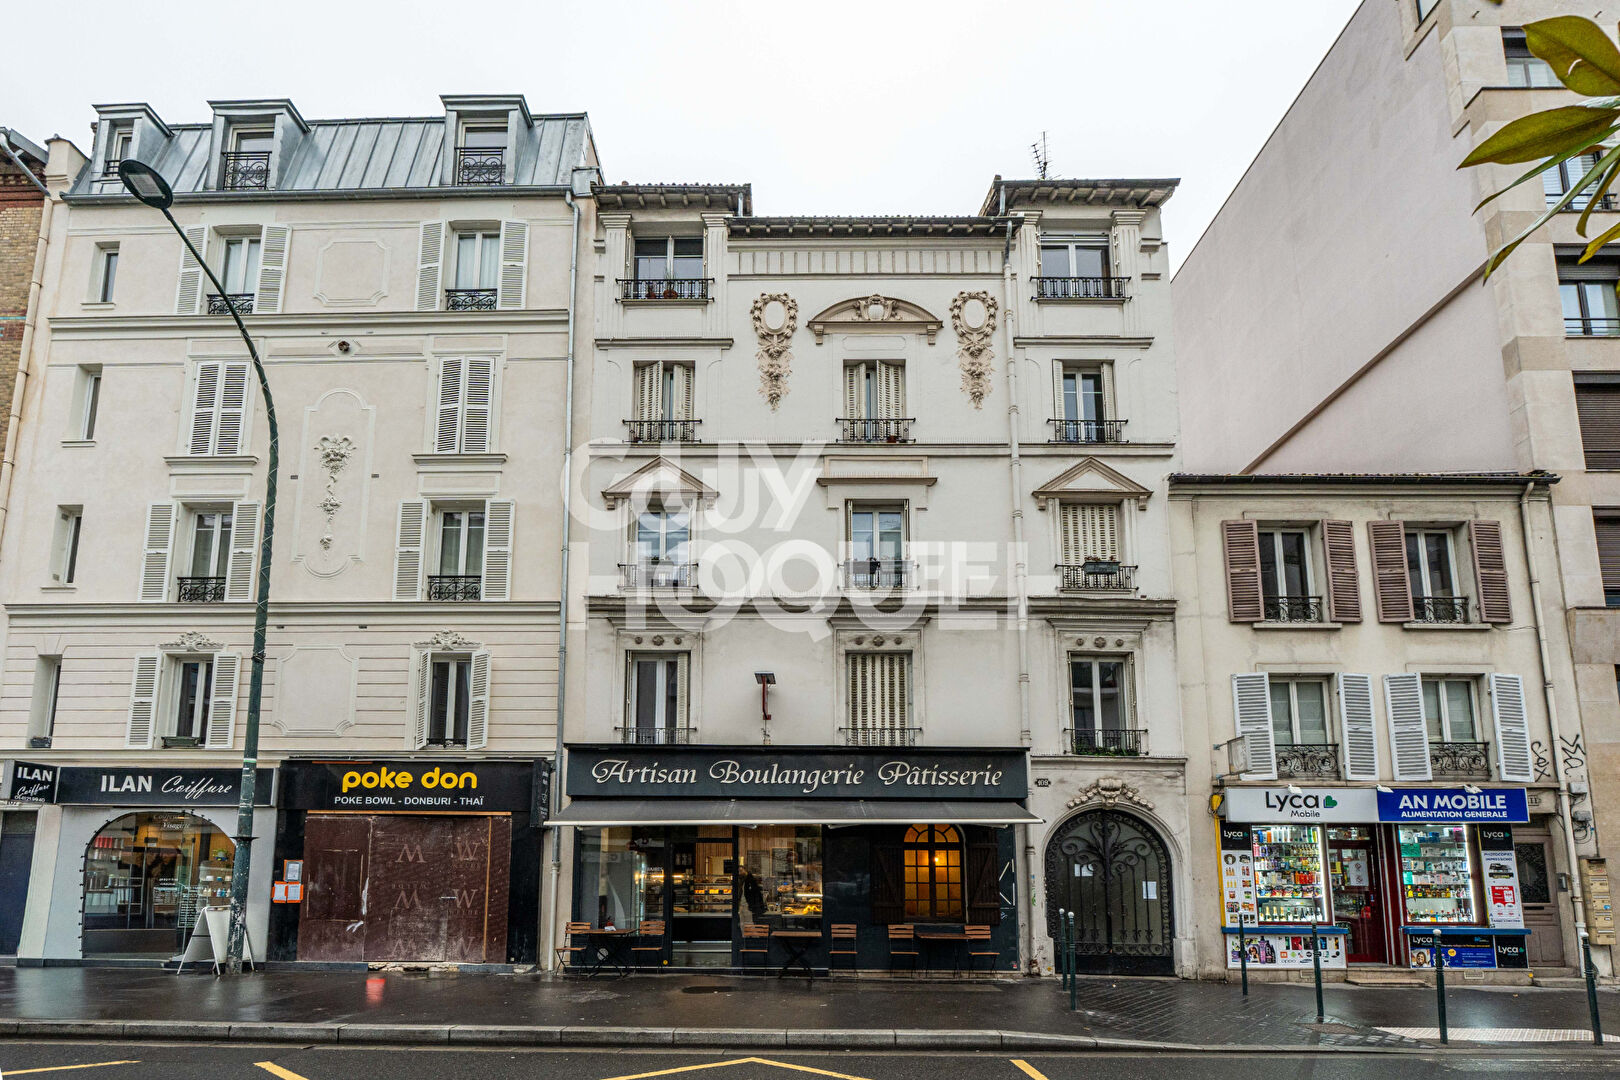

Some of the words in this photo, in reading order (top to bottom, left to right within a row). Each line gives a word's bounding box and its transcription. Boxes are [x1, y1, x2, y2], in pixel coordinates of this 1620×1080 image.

[17, 766, 53, 782] ILAN
[342, 766, 413, 793] poke
[421, 767, 477, 789] don
[591, 760, 697, 784] Artisan
[709, 760, 864, 793] Boulangerie
[877, 760, 1002, 786] Pâtisserie
[100, 775, 153, 792] ILAN
[161, 775, 233, 800] Coiffure
[334, 796, 362, 805] POKE
[365, 796, 396, 805] BOWL
[404, 796, 451, 805] DONBURI
[460, 796, 484, 805] THAÏ
[1265, 791, 1320, 812] Lyca
[1398, 795, 1428, 809] AN
[1433, 795, 1507, 809] MOBILE
[1223, 830, 1243, 838] Lyca
[1412, 935, 1433, 944] Lyca
[1498, 946, 1518, 955] Lyca
